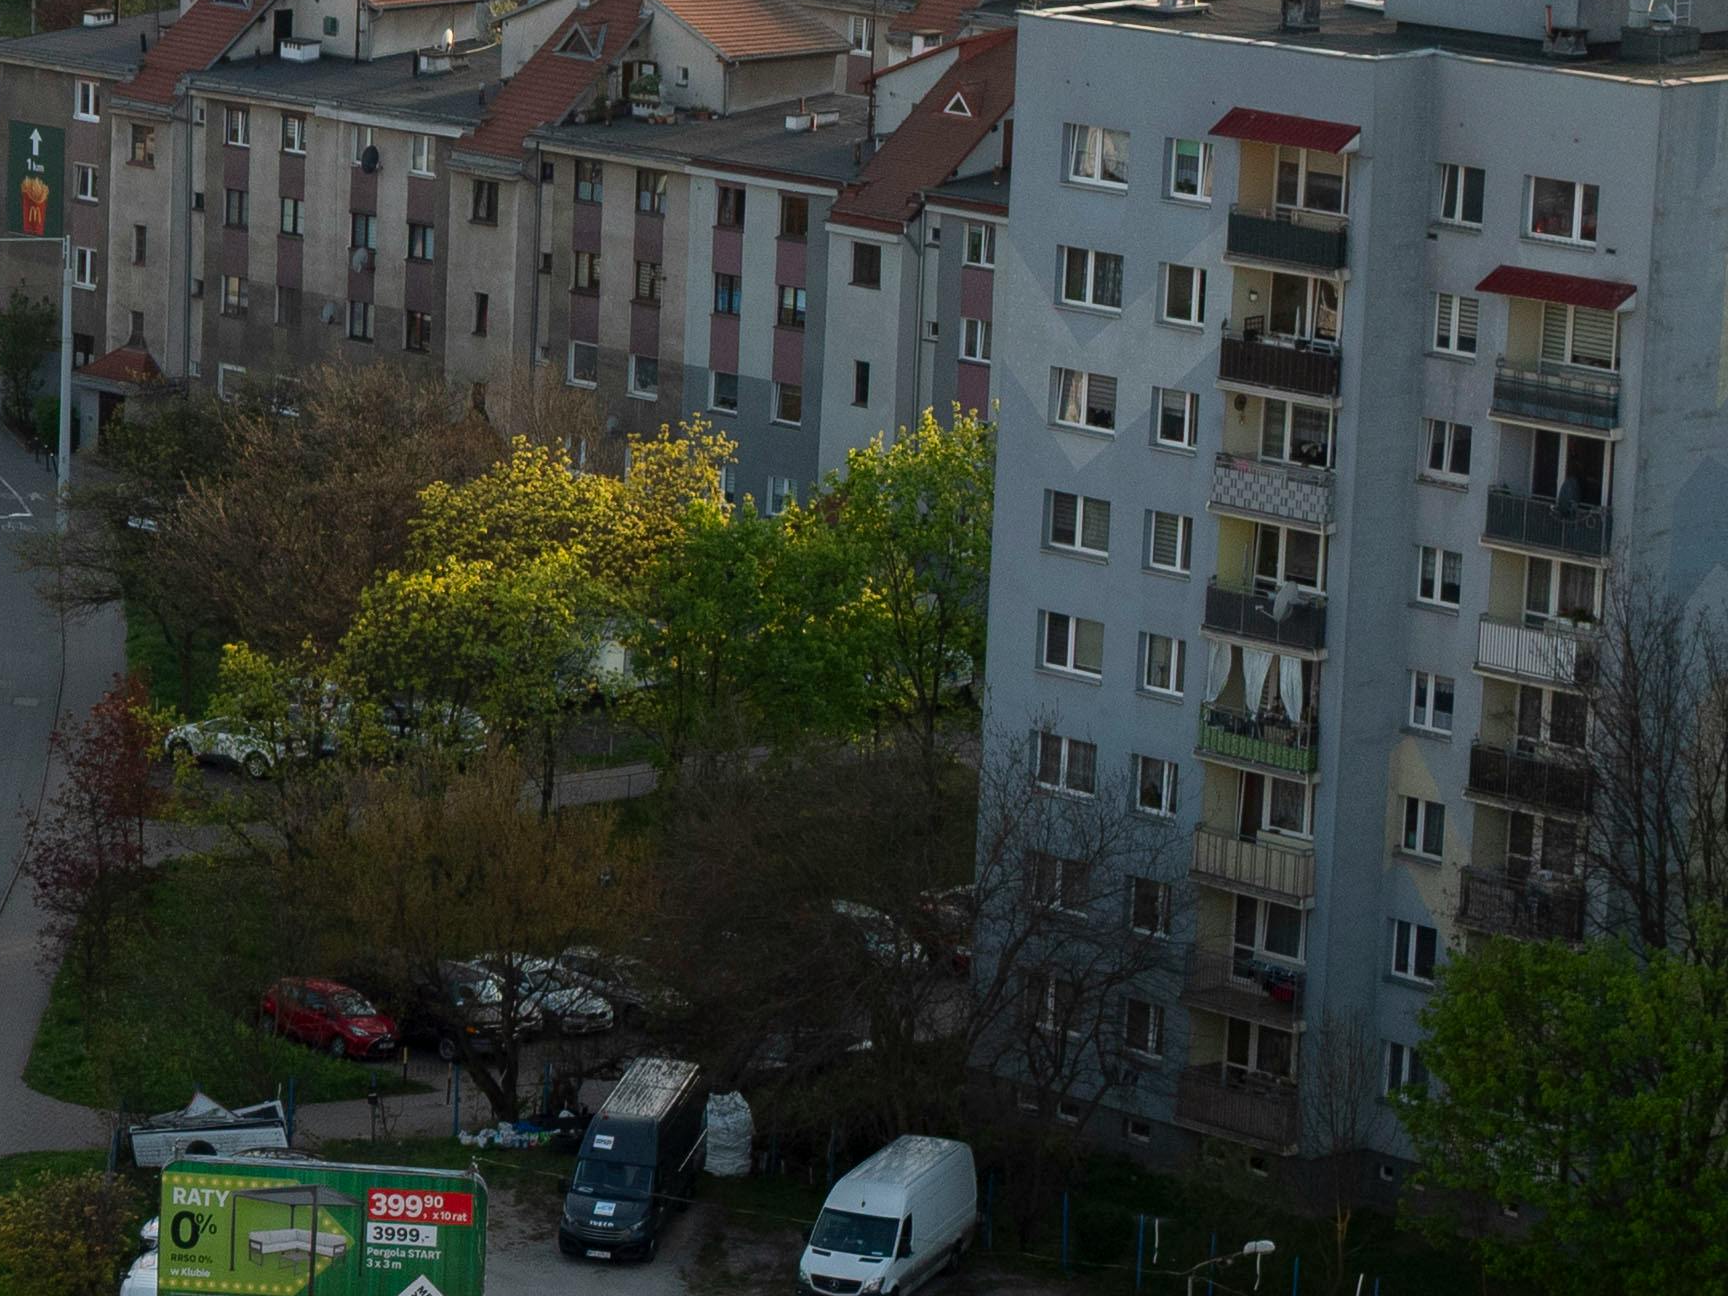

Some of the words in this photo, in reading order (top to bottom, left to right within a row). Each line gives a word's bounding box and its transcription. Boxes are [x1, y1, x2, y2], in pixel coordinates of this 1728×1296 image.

[27, 158, 32, 171] 1
[173, 1186, 231, 1207] RATY
[452, 1212, 467, 1222] rat
[171, 1210, 217, 1249] 0%
[170, 1253, 197, 1263] RRSO
[198, 1254, 213, 1264] 0%
[366, 1246, 405, 1259] Pergola
[407, 1249, 442, 1260] START
[181, 1267, 211, 1278] Klubie
